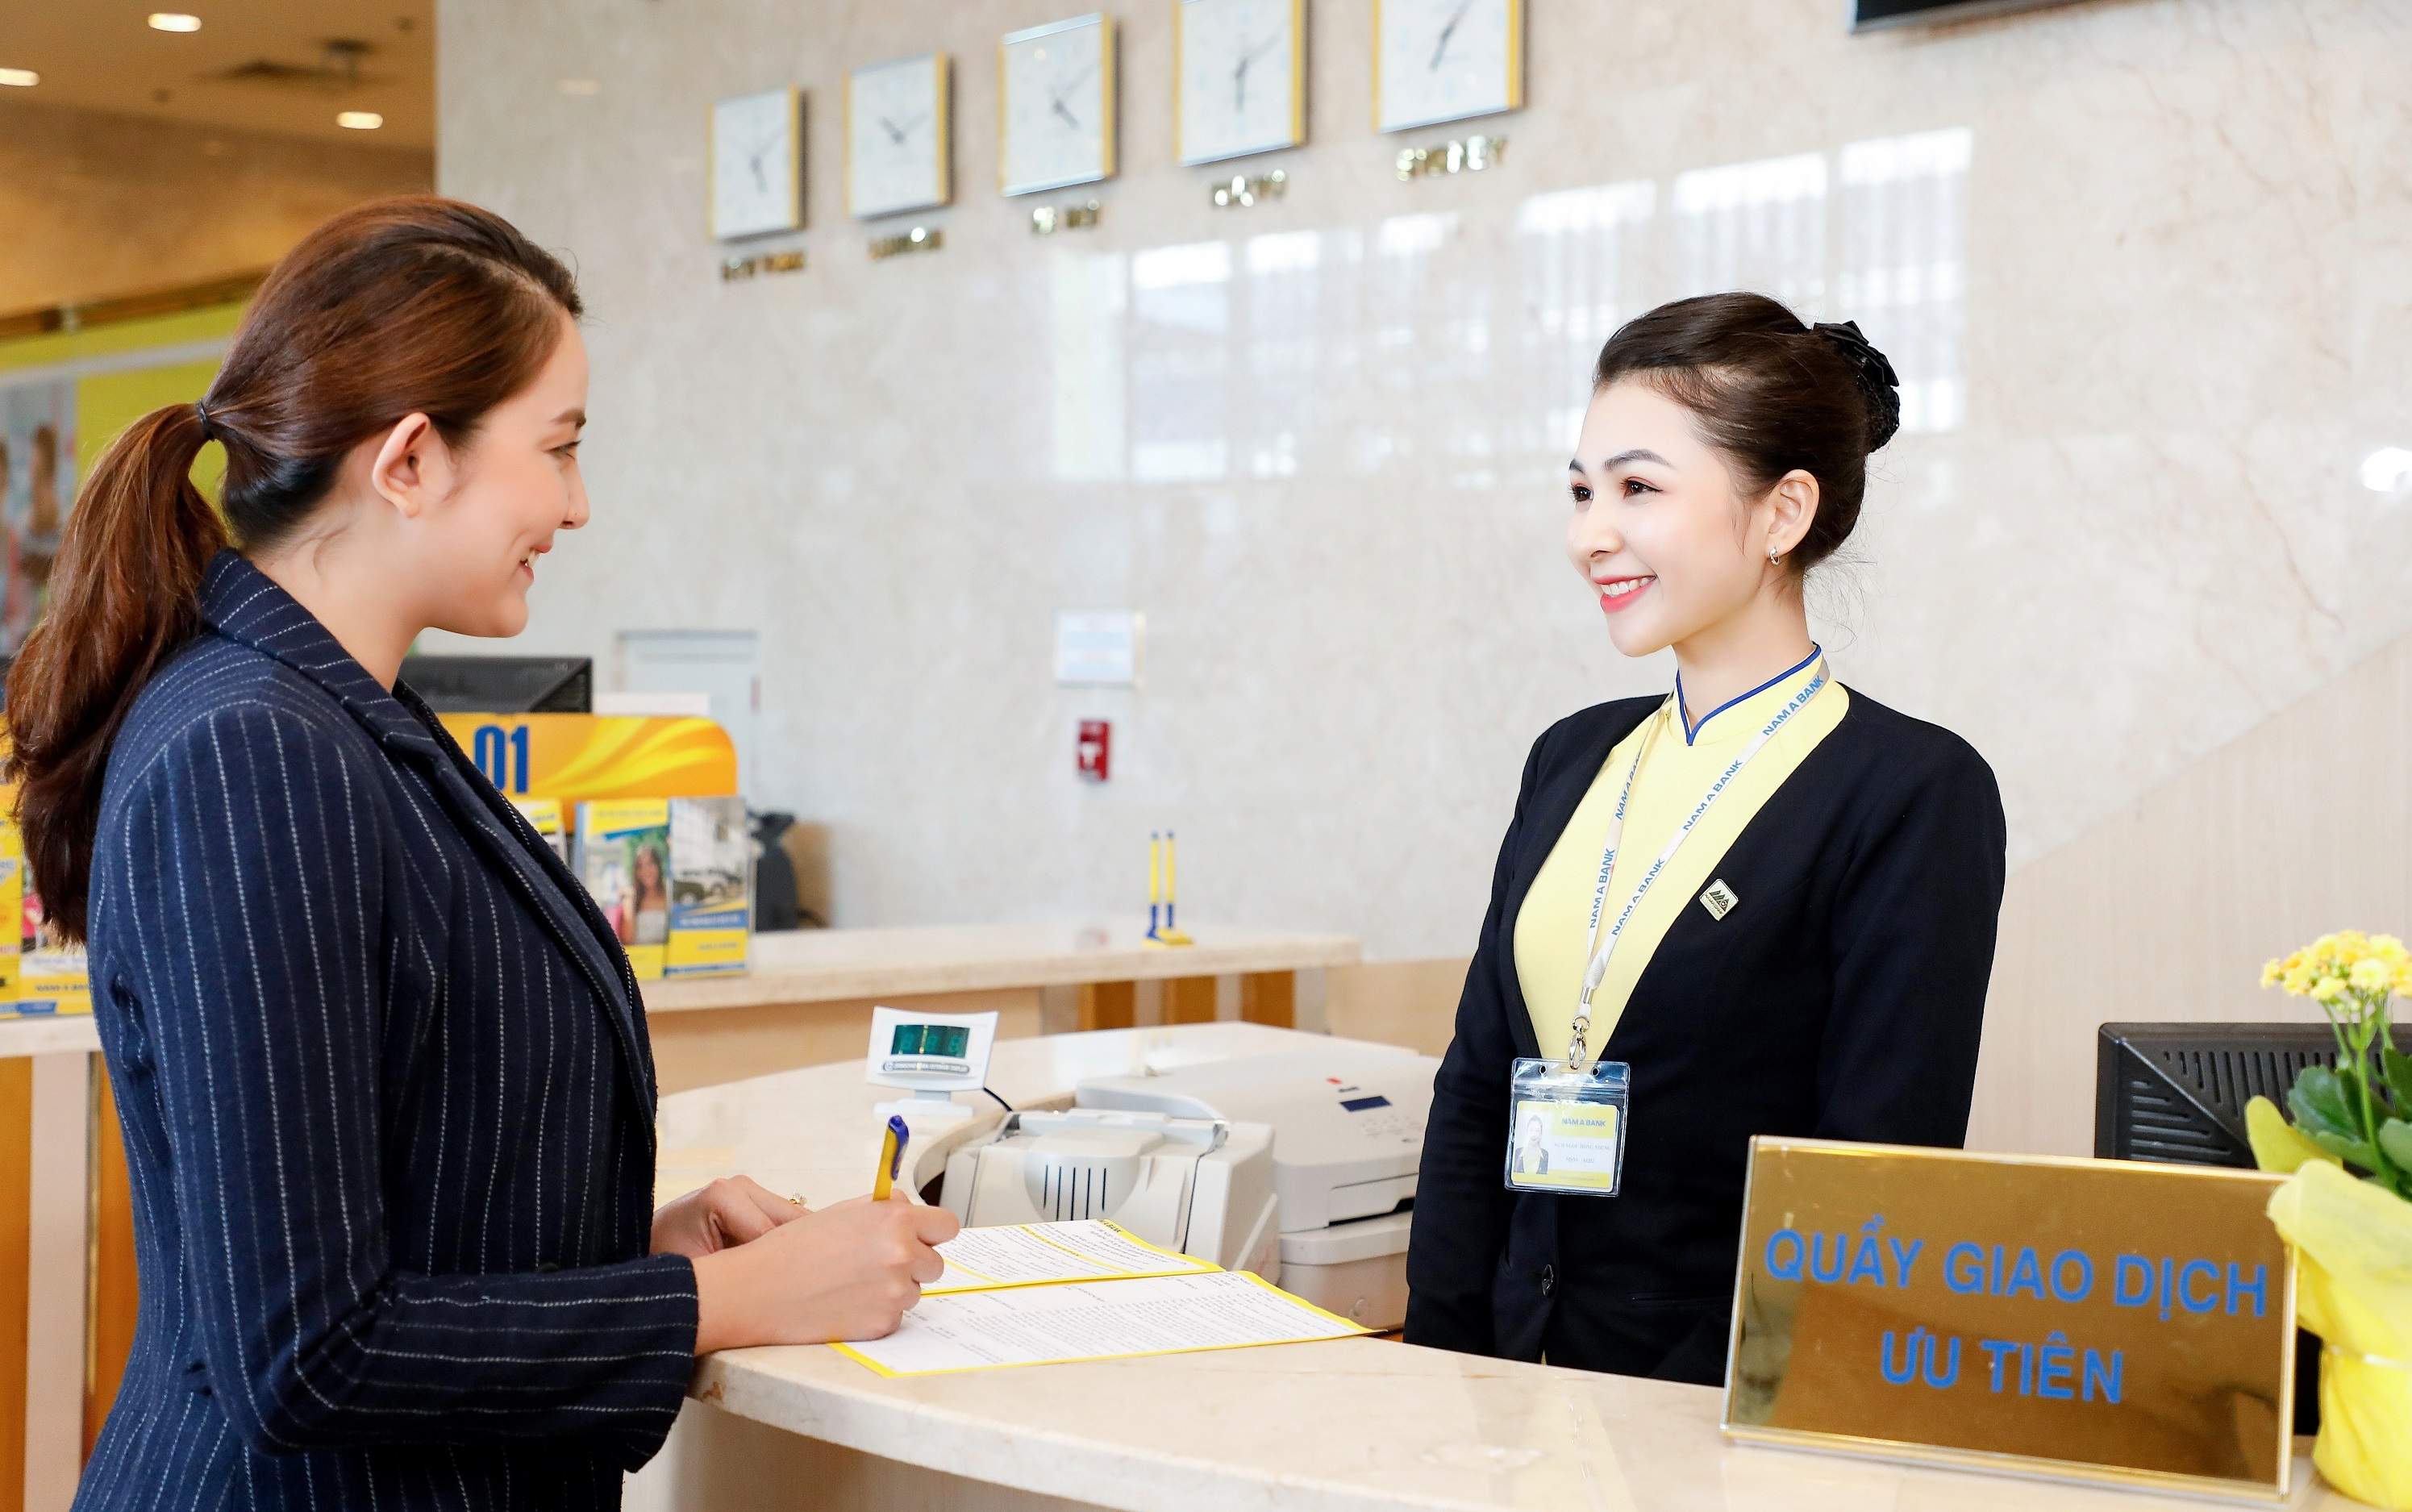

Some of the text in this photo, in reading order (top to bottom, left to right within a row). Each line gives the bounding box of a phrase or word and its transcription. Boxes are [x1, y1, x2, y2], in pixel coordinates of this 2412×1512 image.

[1763, 675, 1823, 735] NAM A BANK
[475, 726, 528, 793] 01
[1615, 789, 1628, 820] NAM
[1683, 760, 1743, 831] NAM A BANK
[1589, 848, 1615, 929] NAM A BANK
[1611, 858, 1665, 935] NAM A BANK
[1585, 1119, 1606, 1127] BANK
[1944, 1241, 2094, 1302] GIAO
[2114, 1253, 2267, 1321] DỊCH
[1881, 1326, 2123, 1404] ƯU TIÊN
